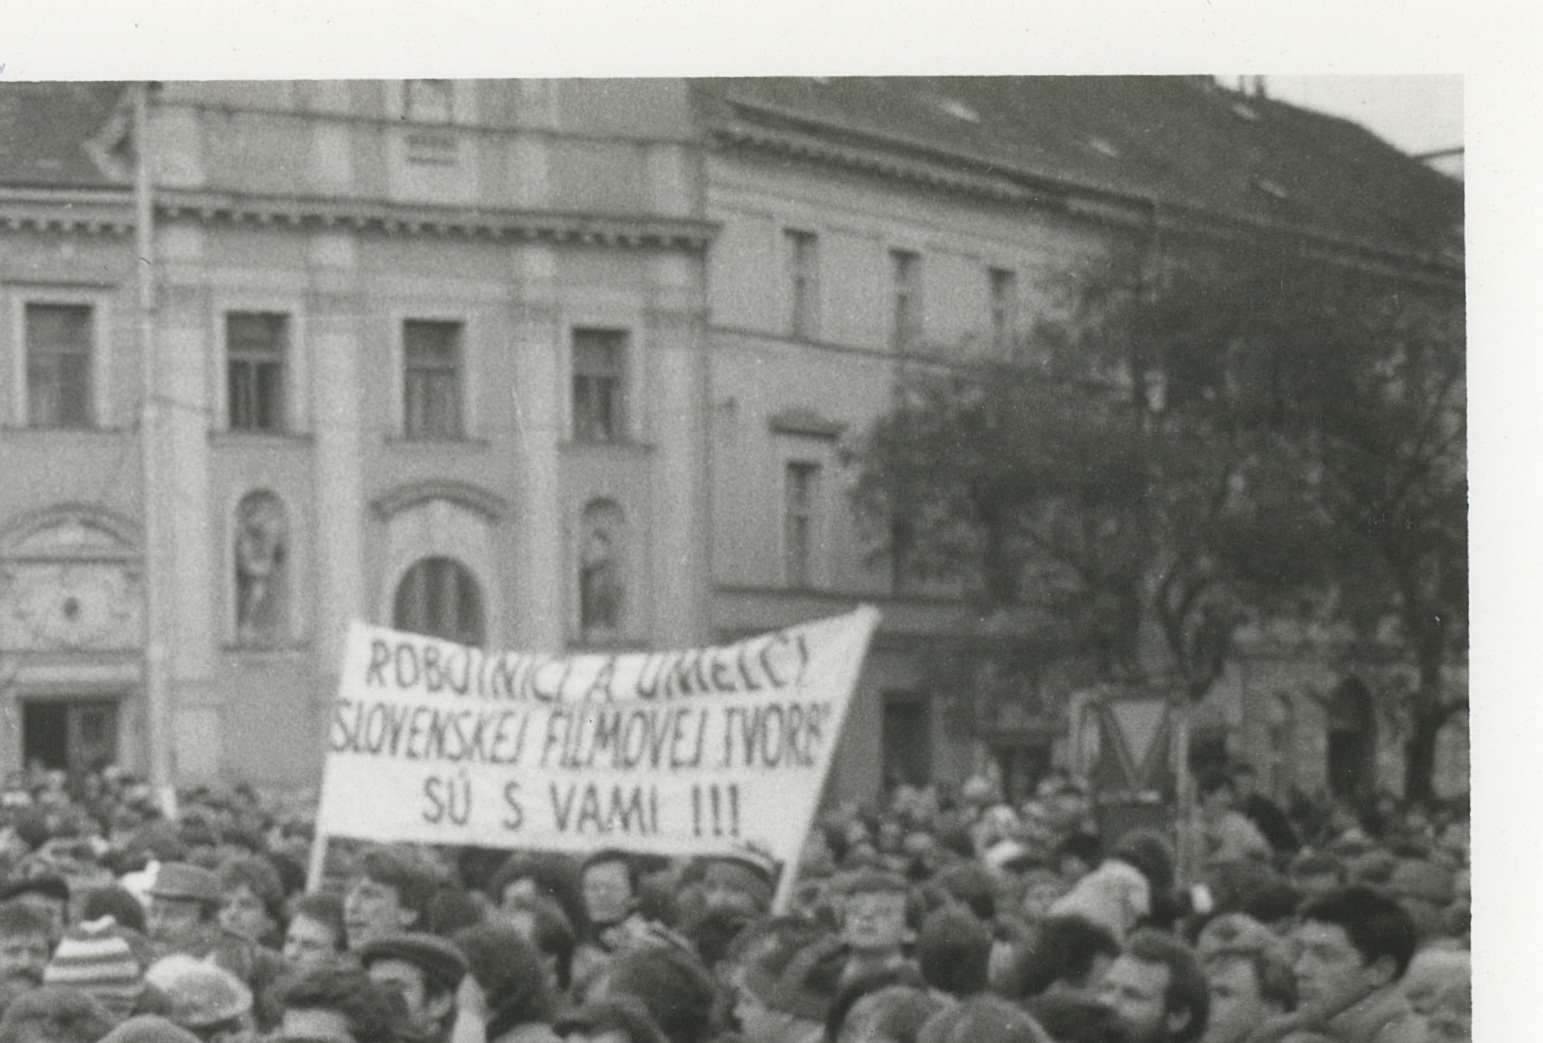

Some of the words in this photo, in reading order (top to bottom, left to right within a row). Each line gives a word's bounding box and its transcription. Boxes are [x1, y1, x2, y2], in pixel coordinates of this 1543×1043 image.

[585, 653, 616, 703] A
[329, 697, 529, 764] SLOVENSKEJ
[541, 704, 708, 769] FILMOVEJ
[502, 780, 525, 831] S
[549, 782, 659, 836] VAMI
[692, 783, 740, 838] !!!
